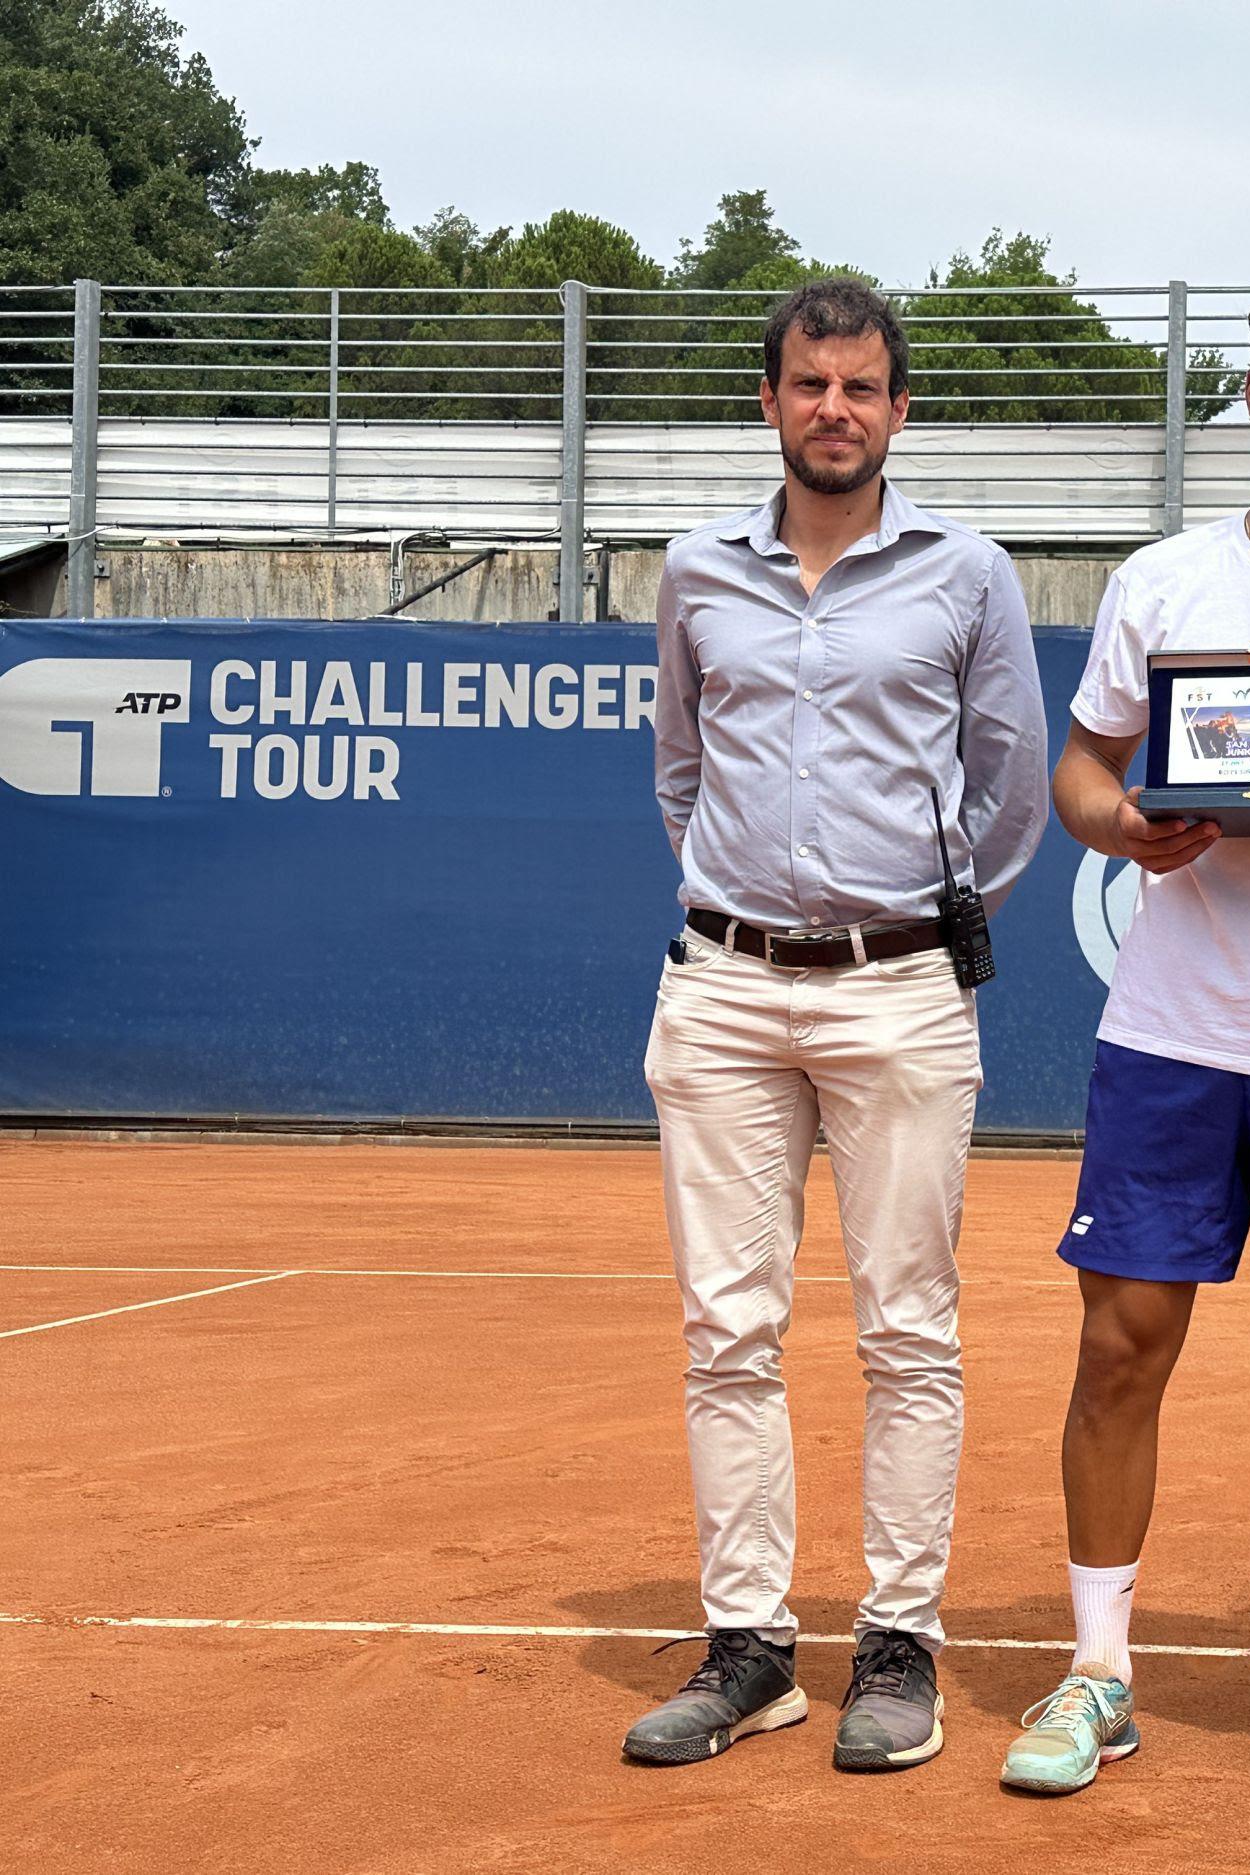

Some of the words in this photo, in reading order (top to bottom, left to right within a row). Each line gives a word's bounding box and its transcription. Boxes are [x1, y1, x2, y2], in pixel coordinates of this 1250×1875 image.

[114, 692, 182, 714] ATP
[210, 659, 659, 730] CHALLENGER
[1225, 740, 1247, 749] SAN
[209, 734, 400, 800] TOUR
